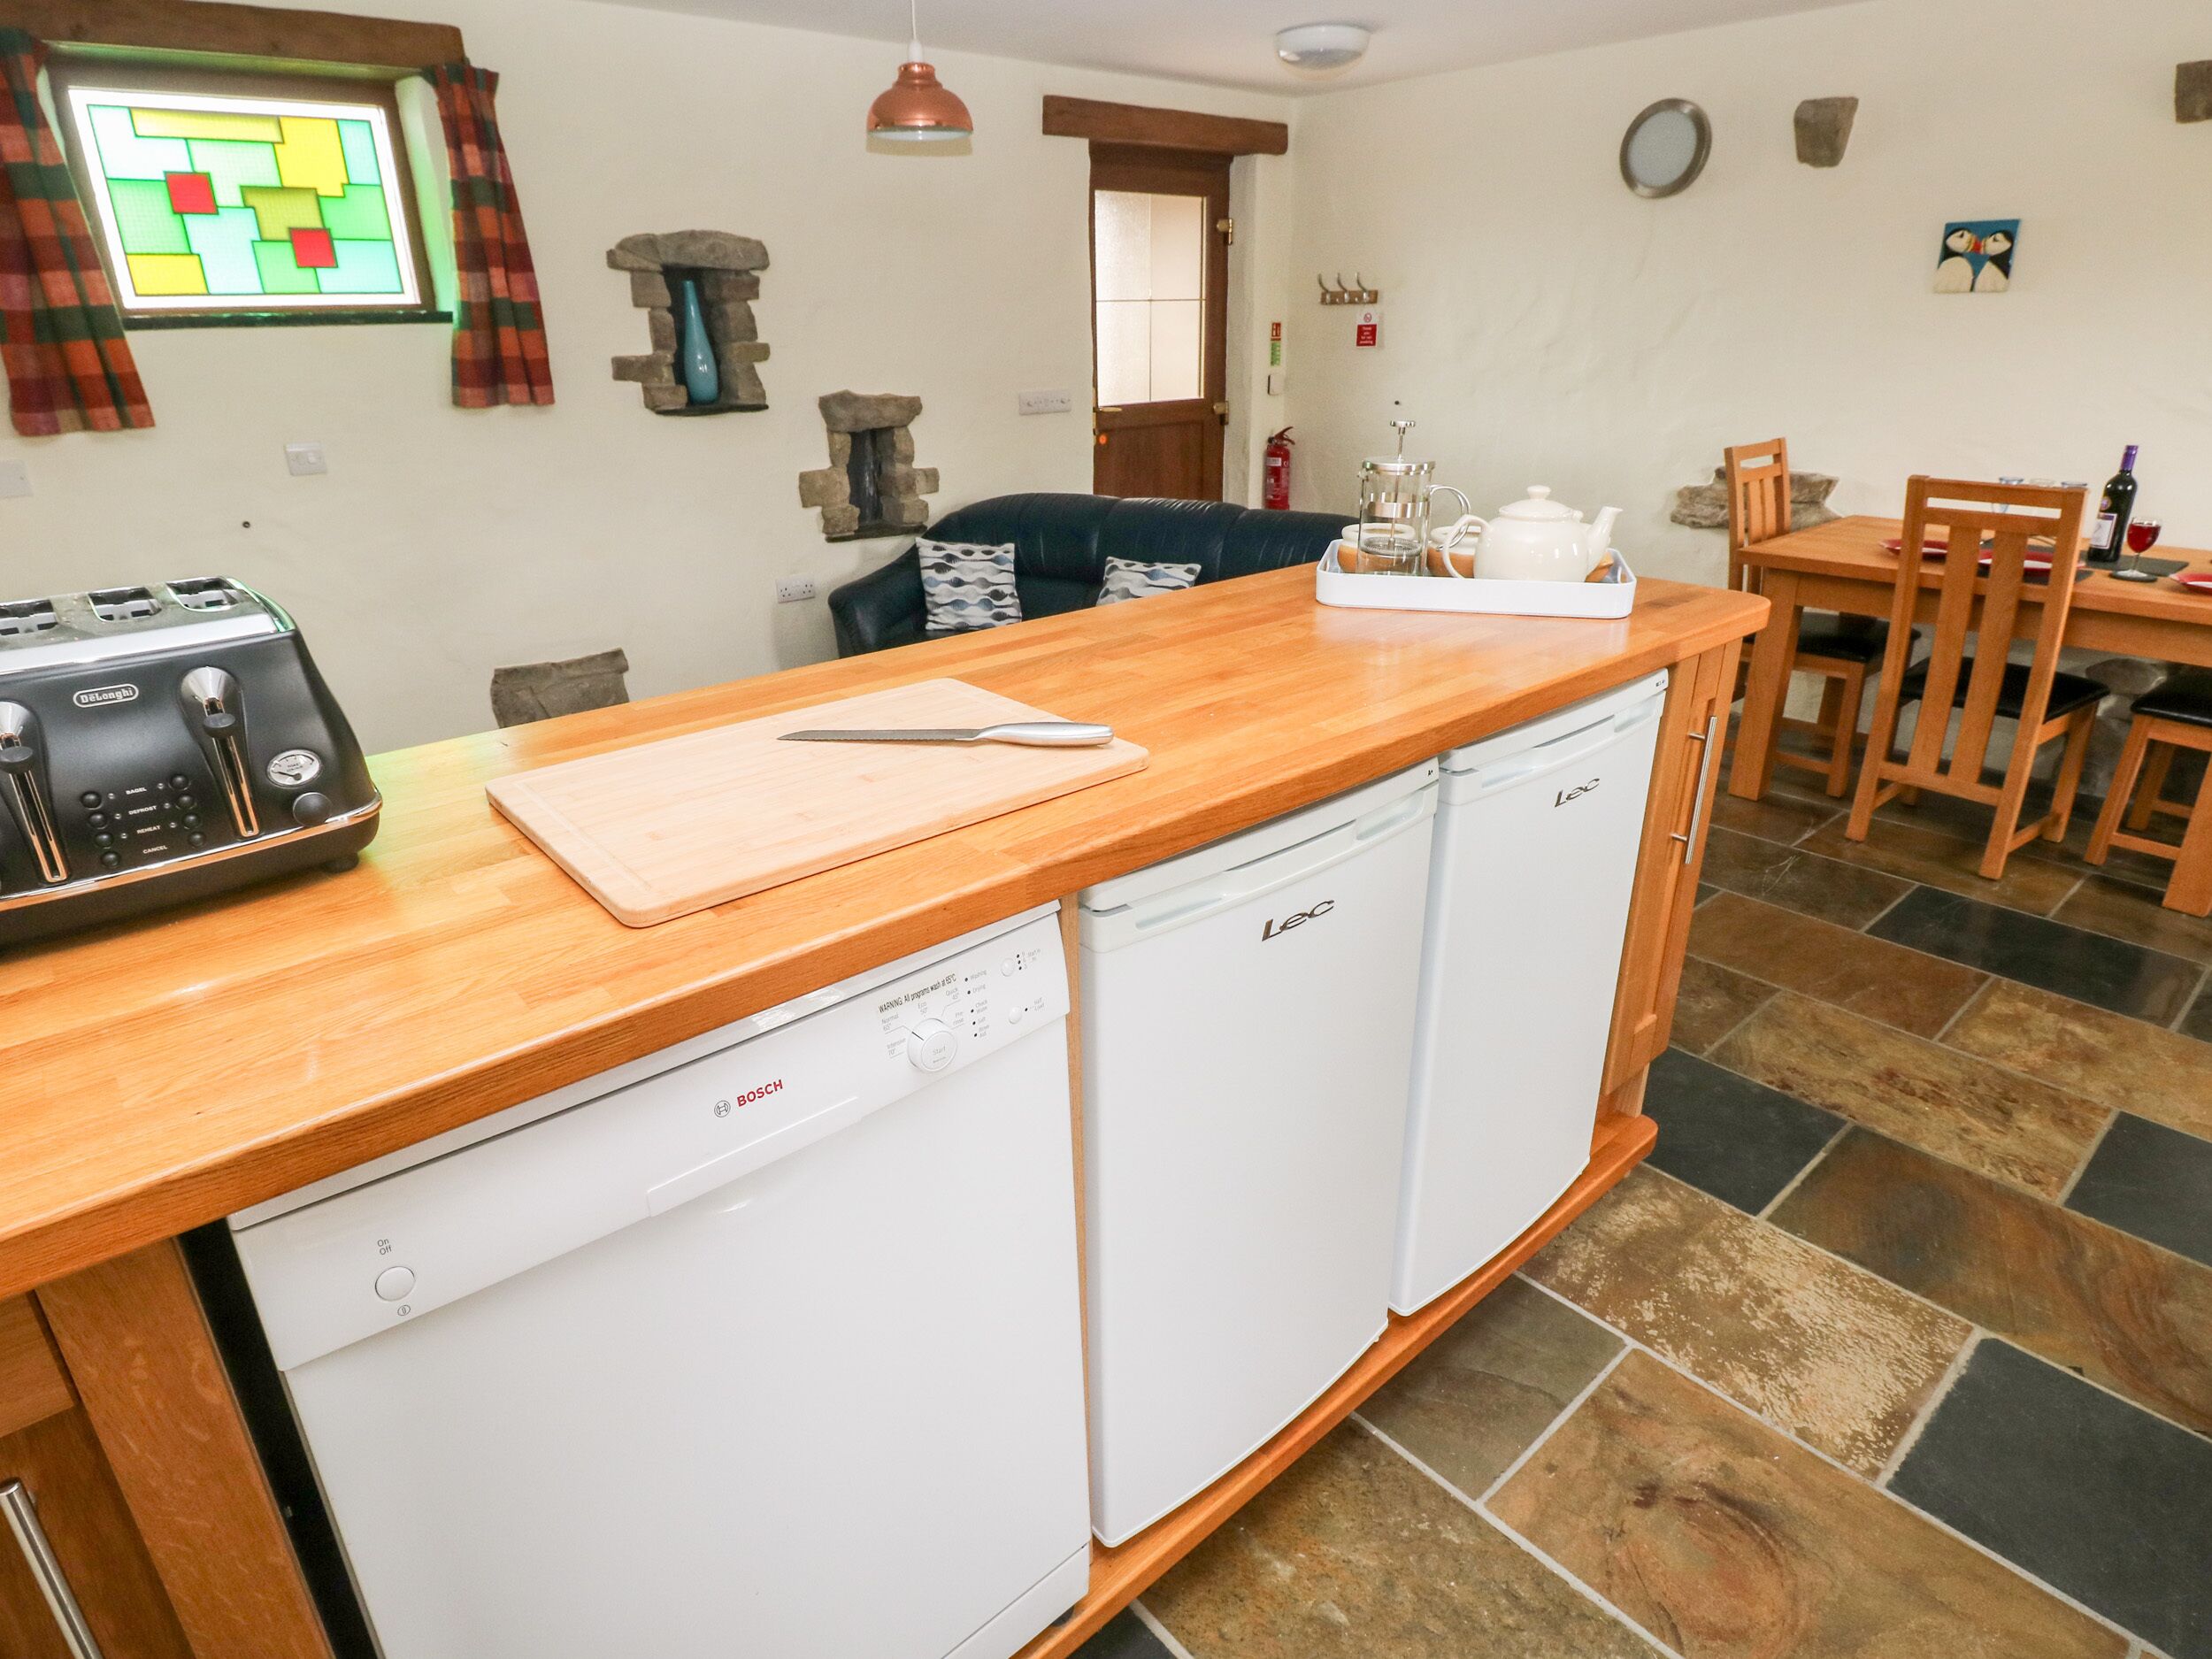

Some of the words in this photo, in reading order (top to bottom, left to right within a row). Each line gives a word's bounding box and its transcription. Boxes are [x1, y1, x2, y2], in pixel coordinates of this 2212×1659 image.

[126, 787, 147, 795] BAGEL
[128, 805, 157, 815] DEFROST
[136, 825, 161, 834] REHEAT
[142, 845, 168, 855] CANCEL
[910, 987, 931, 1002] programs
[930, 980, 941, 992] wash
[881, 1012, 899, 1025] Normal
[932, 1045, 947, 1056] Start
[737, 1079, 783, 1107] BOSCH
[379, 1245, 392, 1256] Off
